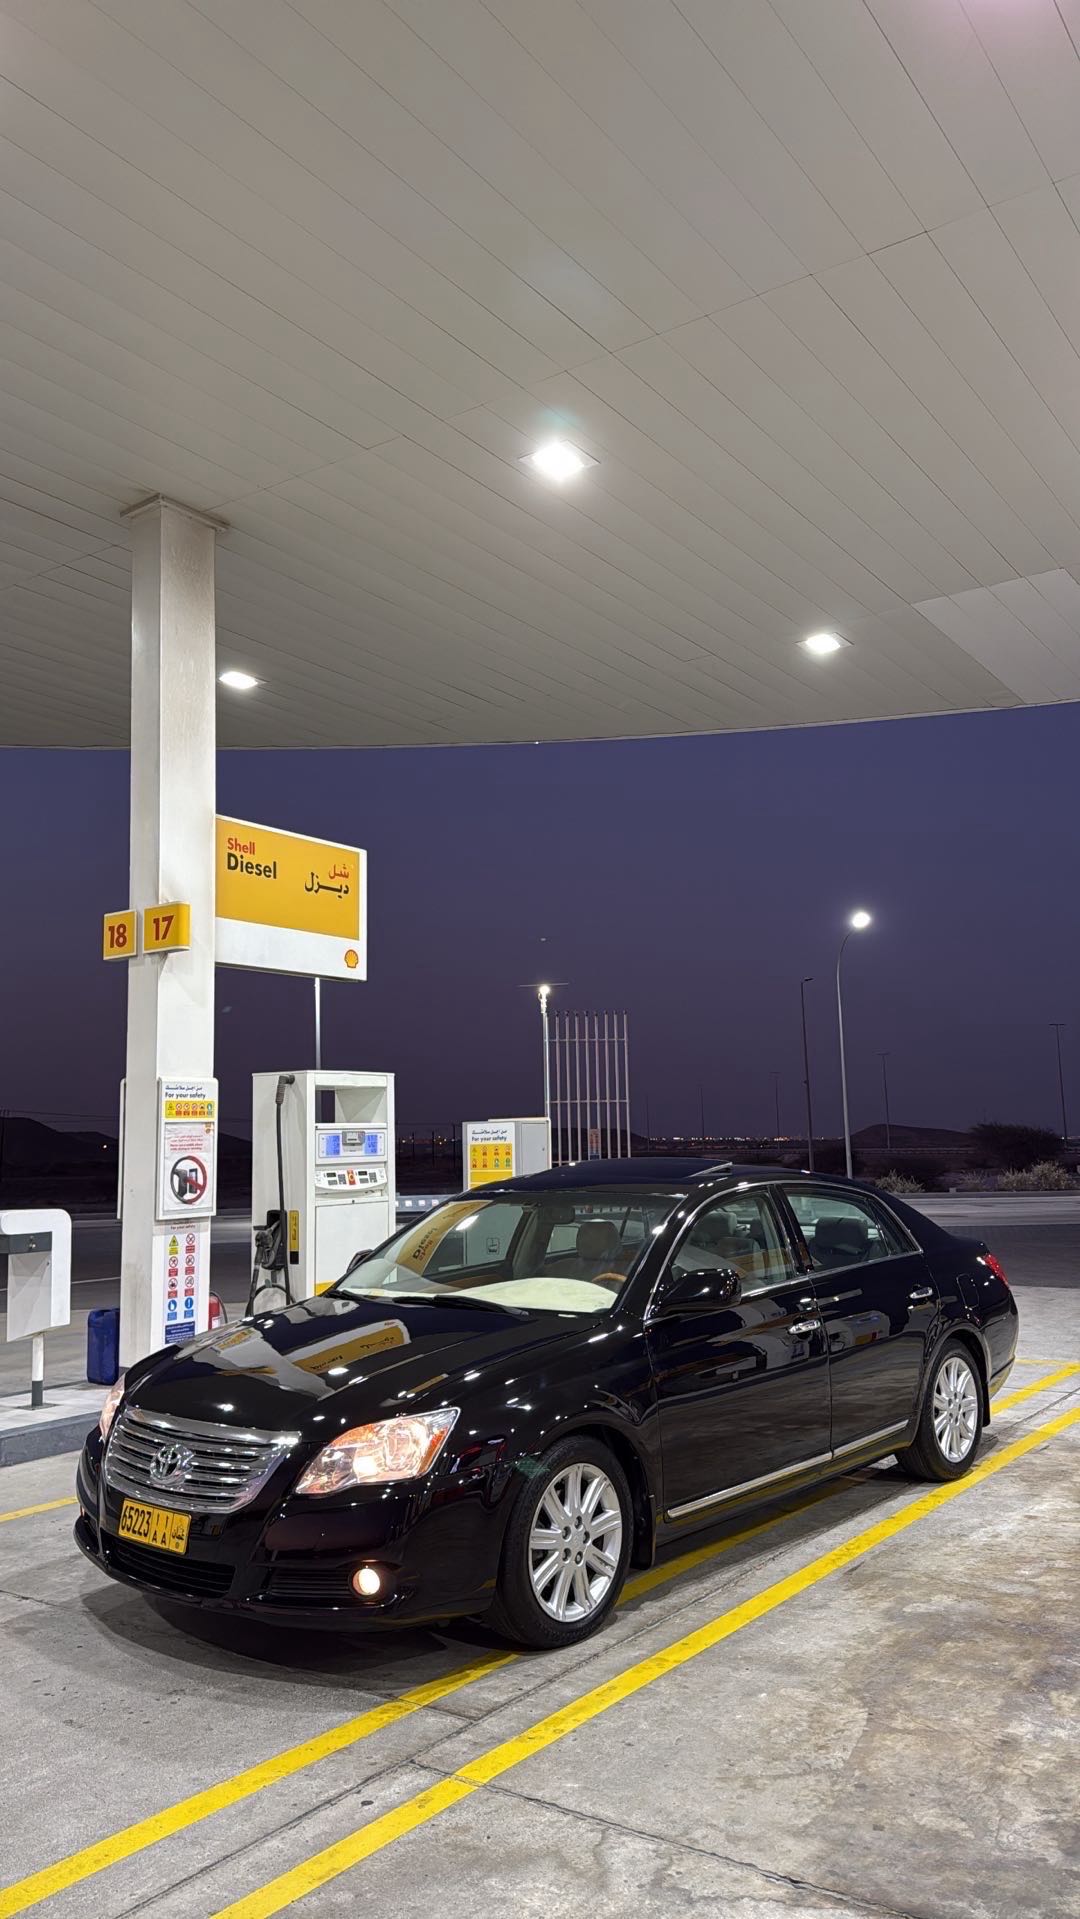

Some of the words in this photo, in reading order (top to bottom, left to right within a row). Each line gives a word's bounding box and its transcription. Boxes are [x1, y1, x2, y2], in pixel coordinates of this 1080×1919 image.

[227, 837, 256, 855] Shell
[227, 852, 277, 879] Diesel
[328, 863, 350, 880] شل
[304, 872, 350, 898] ديزل
[108, 923, 127, 948] 18
[153, 915, 174, 941] 17
[176, 1092, 188, 1100] your
[189, 1091, 206, 1100] safety
[121, 1505, 152, 1537] 65223
[152, 1530, 158, 1543] A
[160, 1532, 167, 1546] A
